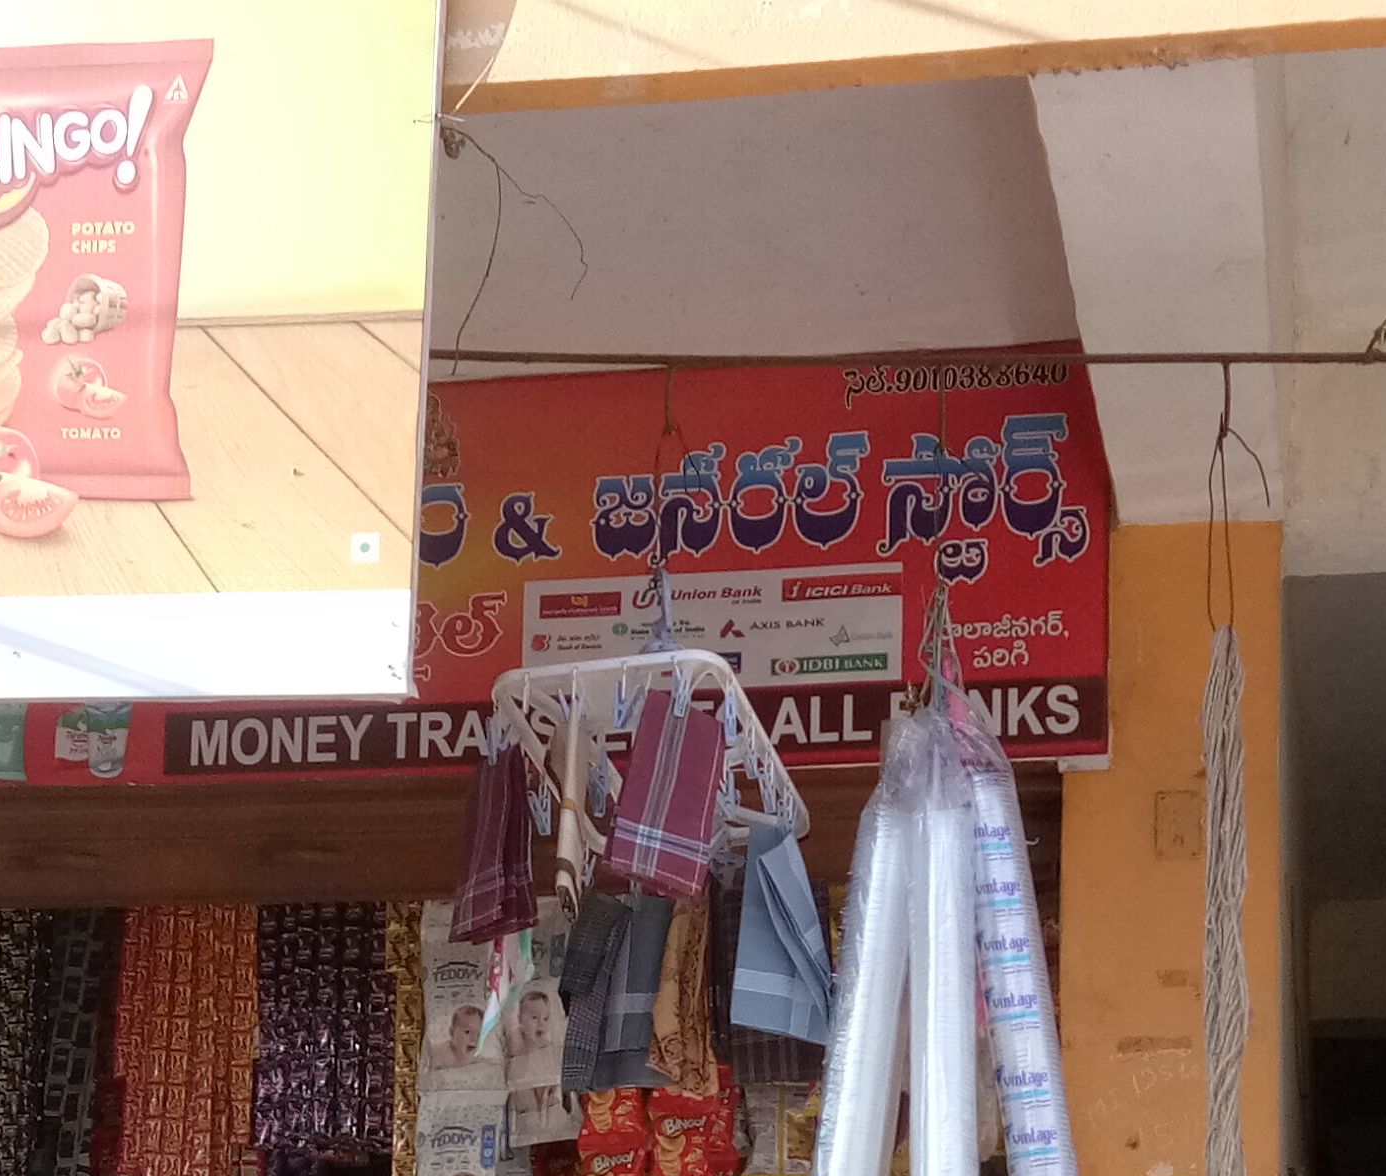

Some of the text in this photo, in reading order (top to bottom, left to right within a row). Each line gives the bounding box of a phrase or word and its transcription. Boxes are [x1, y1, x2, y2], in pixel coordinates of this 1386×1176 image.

[70, 221, 135, 236] POTATO
[70, 240, 117, 254] CHIPS
[60, 426, 122, 440] TOMATO
[492, 490, 562, 567] &
[671, 585, 763, 601] Union Bank
[805, 583, 892, 599] ICICI Bank
[749, 617, 826, 631] AXIS BANK
[802, 655, 885, 673] IDBI BANK
[189, 713, 374, 767] MONEY
[770, 695, 873, 744] ALL
[429, 1132, 479, 1149] TEDDYY
